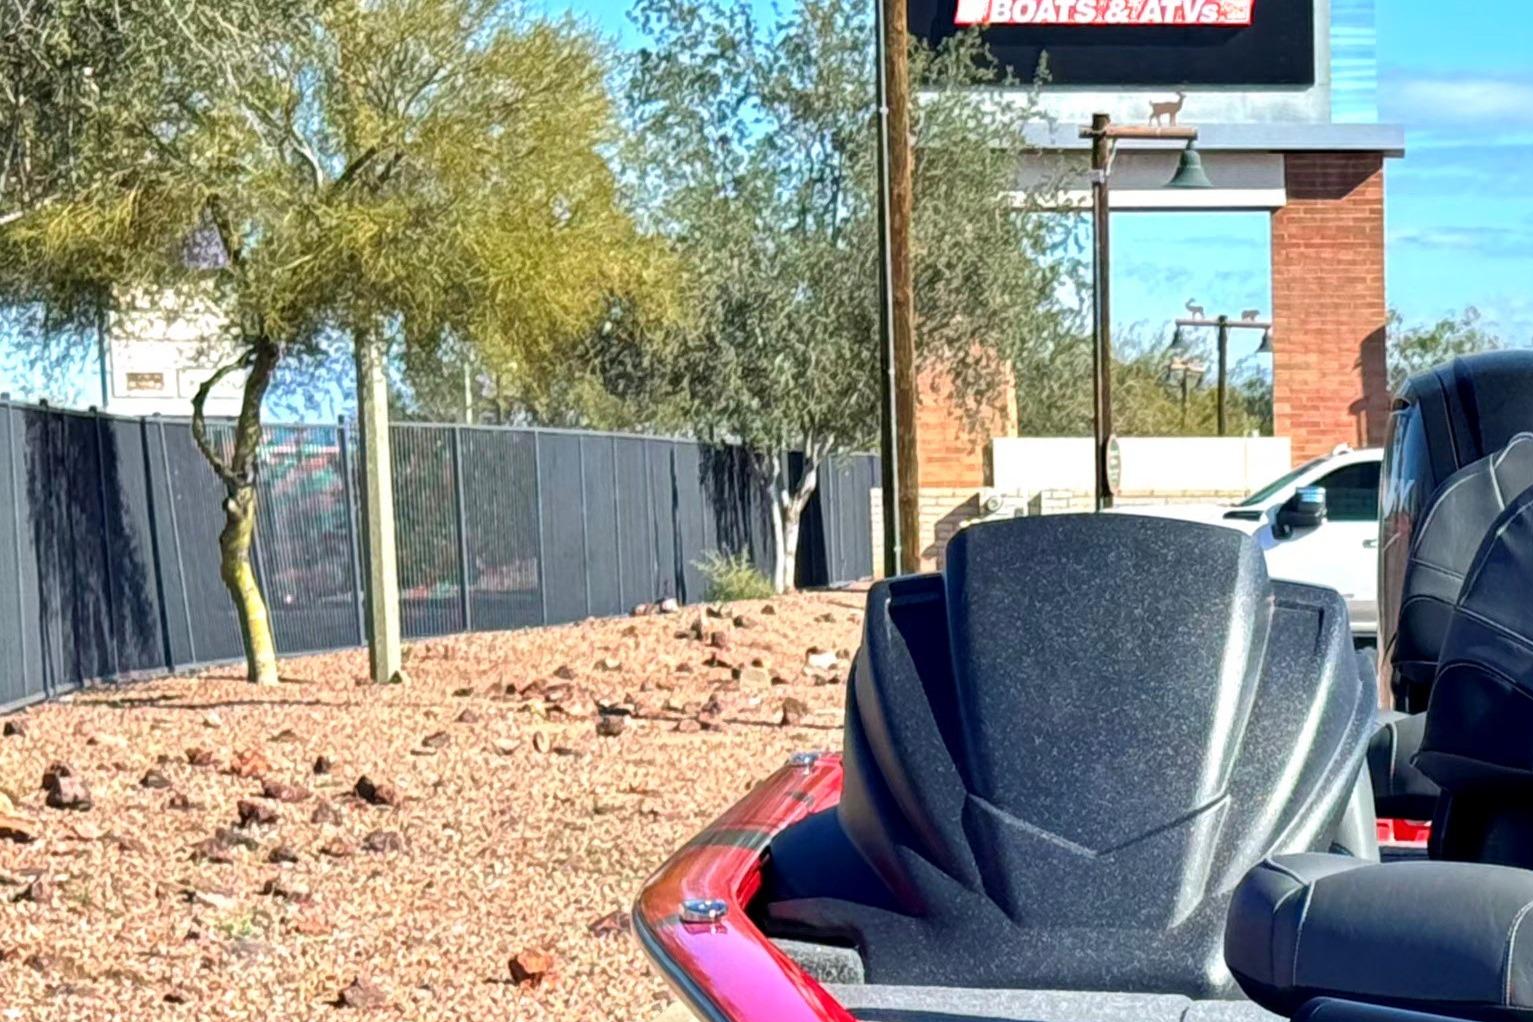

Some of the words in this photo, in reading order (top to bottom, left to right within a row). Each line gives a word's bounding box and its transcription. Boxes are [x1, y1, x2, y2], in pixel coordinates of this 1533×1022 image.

[990, 0, 1097, 23] BOATS
[1104, 0, 1130, 23] &
[1136, 0, 1219, 23] ATVs
